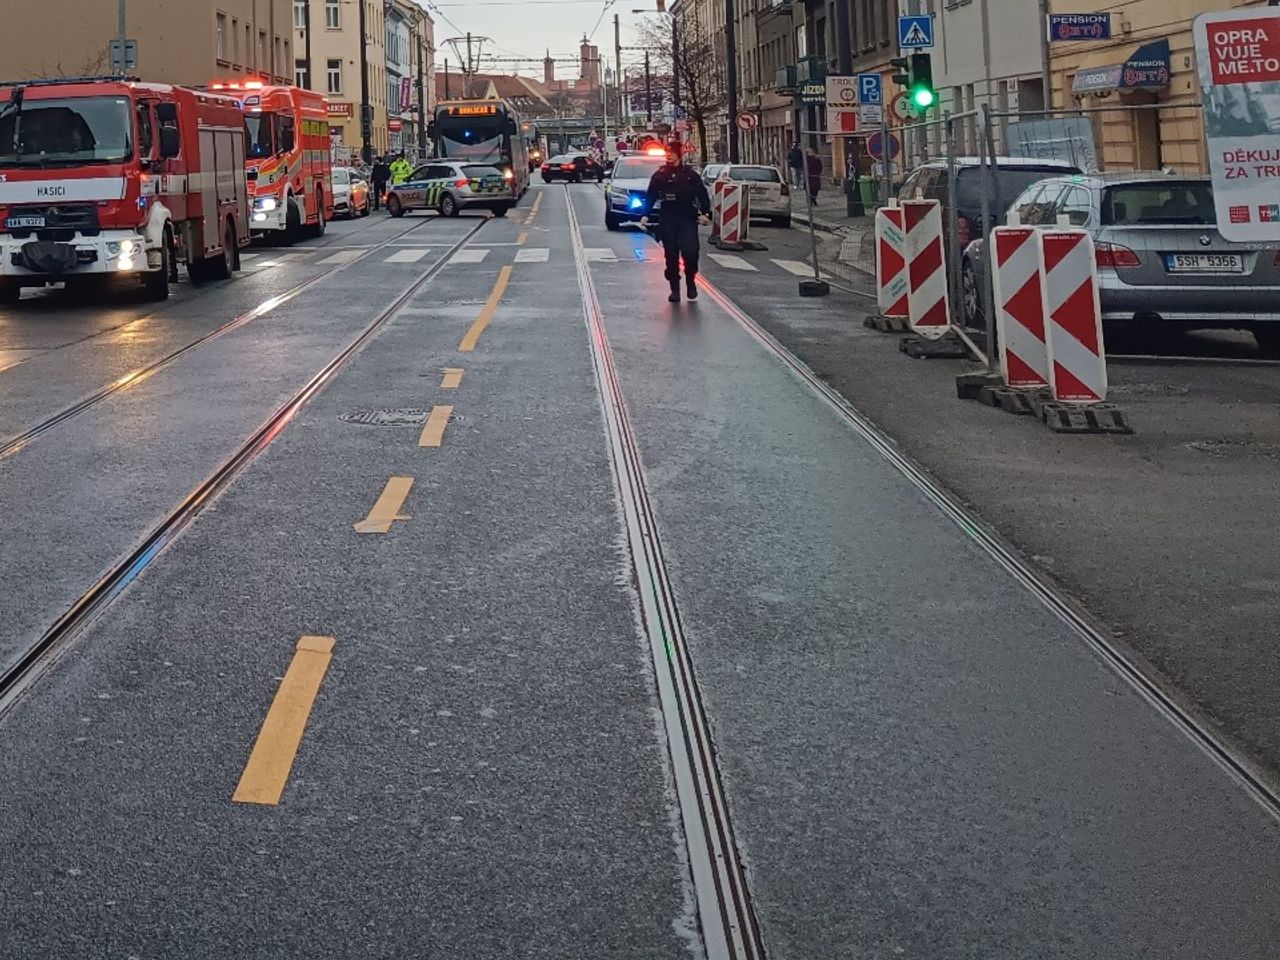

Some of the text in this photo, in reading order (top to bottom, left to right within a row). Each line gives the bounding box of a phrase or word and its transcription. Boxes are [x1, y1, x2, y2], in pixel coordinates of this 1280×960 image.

[1052, 16, 1107, 24] PENSION
[1214, 28, 1269, 46] OPRA
[1215, 44, 1262, 60] VUJE
[1224, 167, 1248, 180] ZA
